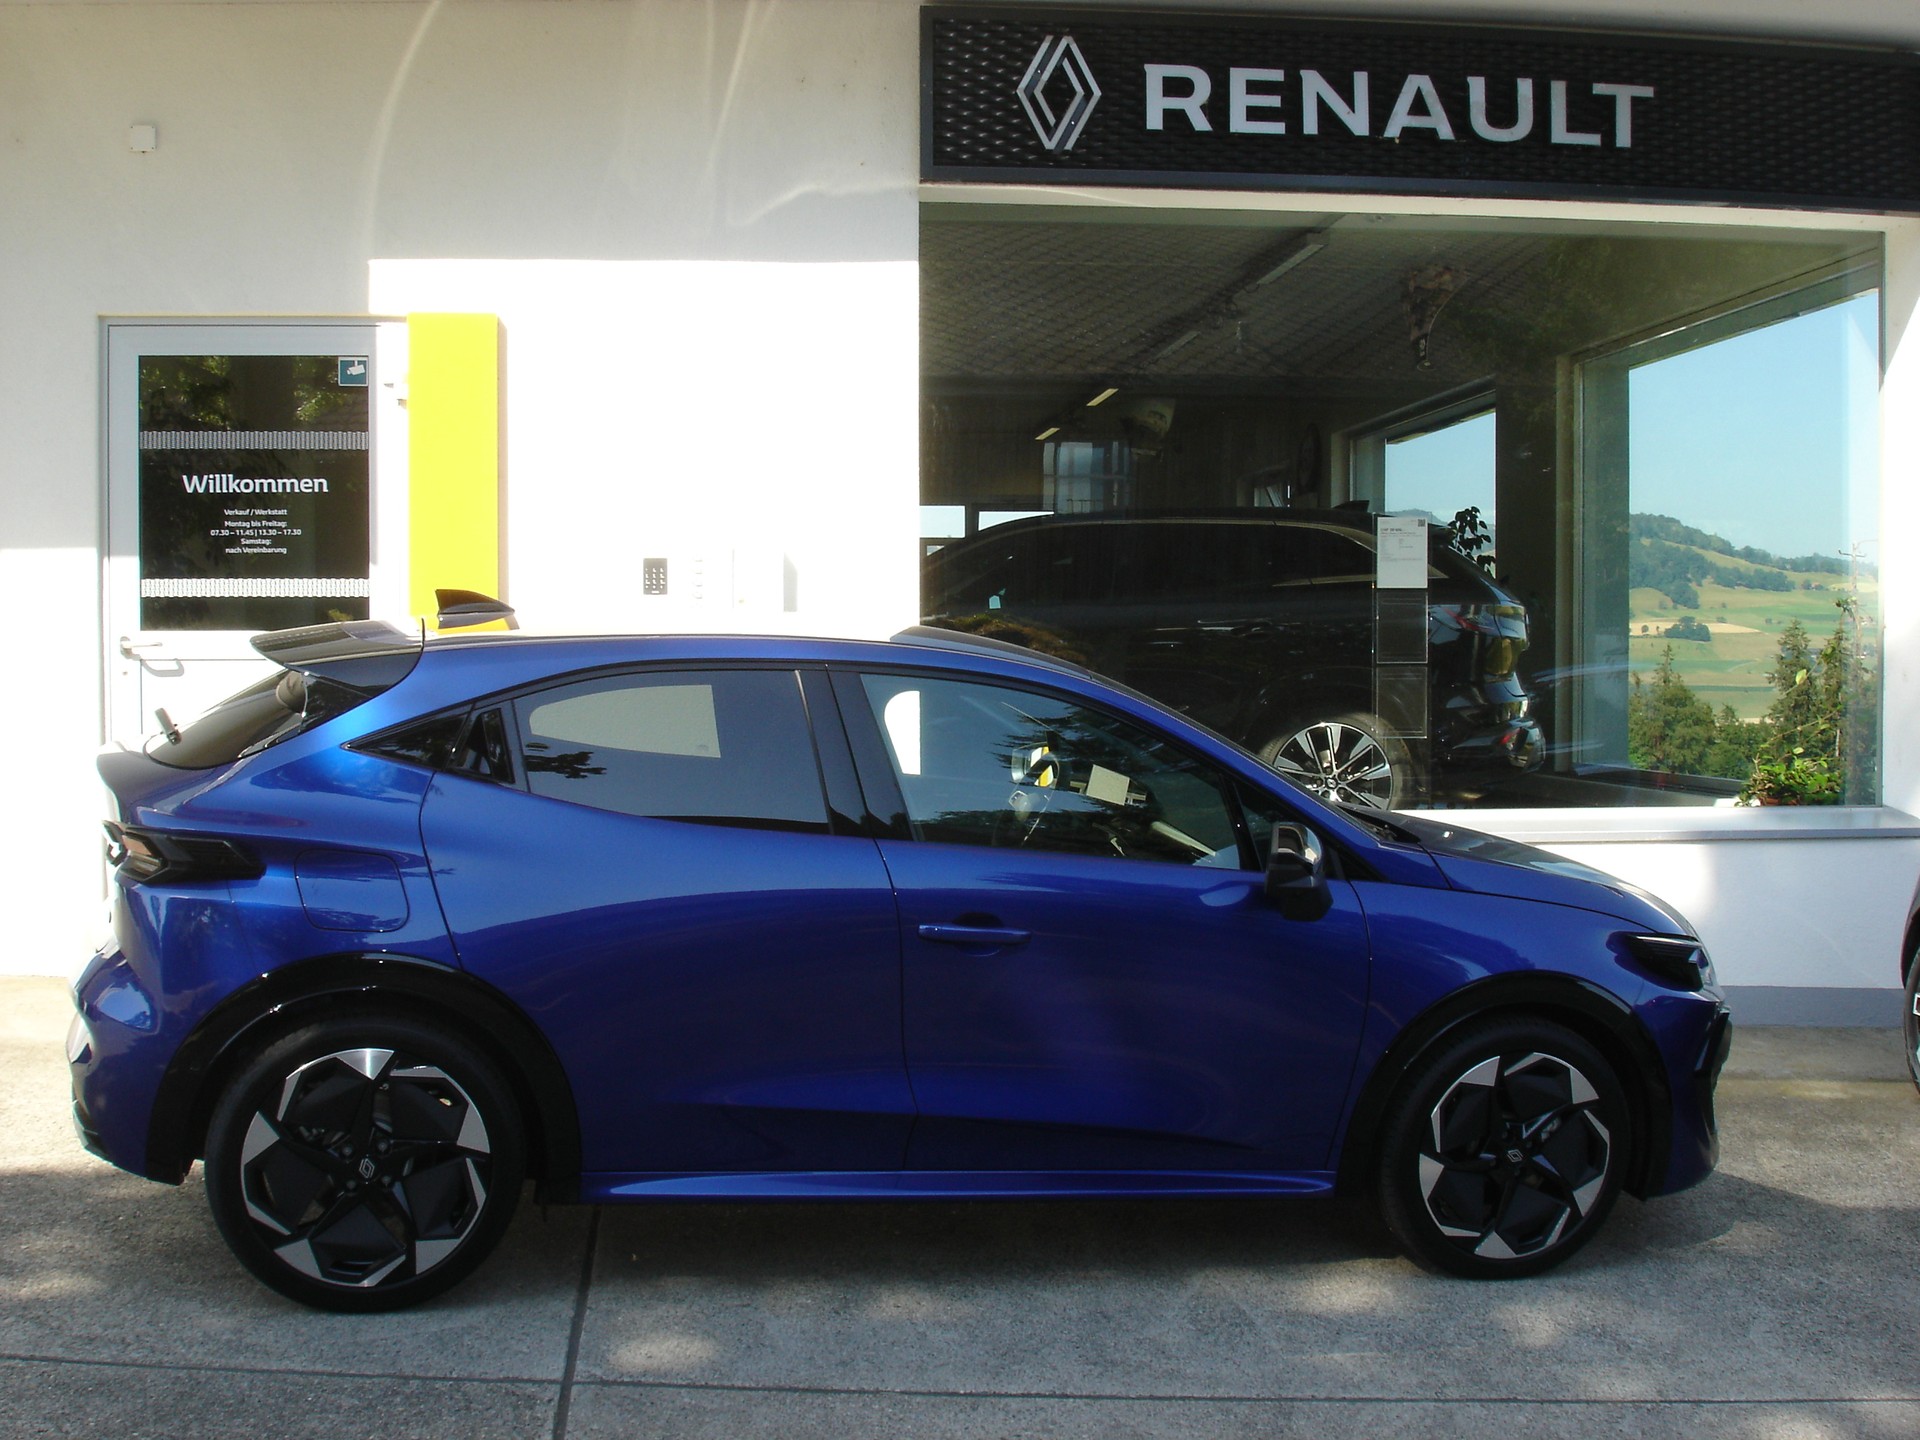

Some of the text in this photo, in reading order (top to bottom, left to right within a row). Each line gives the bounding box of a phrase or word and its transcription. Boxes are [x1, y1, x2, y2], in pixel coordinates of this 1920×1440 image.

[1143, 63, 1655, 148] RENAULT
[182, 474, 329, 493] Willkommen
[224, 520, 250, 528] Montag
[262, 520, 287, 528] Freitag:
[241, 538, 272, 546] Samstag:
[243, 546, 287, 554] Vereinbarung
